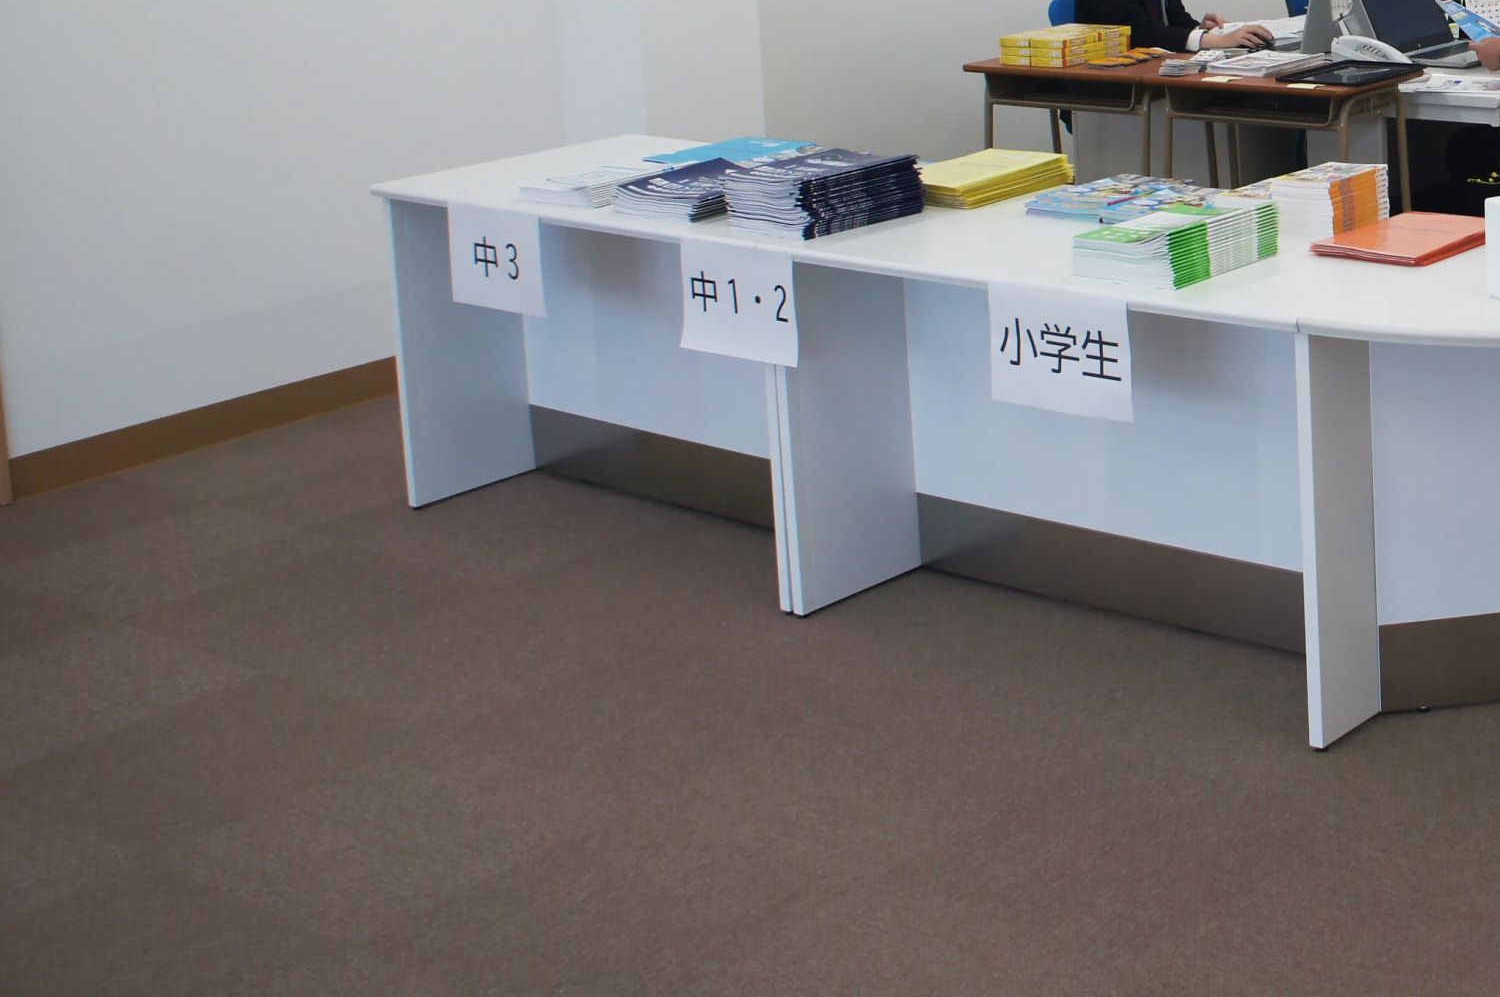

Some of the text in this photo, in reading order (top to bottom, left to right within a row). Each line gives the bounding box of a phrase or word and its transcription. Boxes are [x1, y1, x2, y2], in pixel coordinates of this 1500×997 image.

[473, 235, 520, 281] 中3
[690, 270, 790, 324] 中1・2
[999, 316, 1123, 383] 小学生
